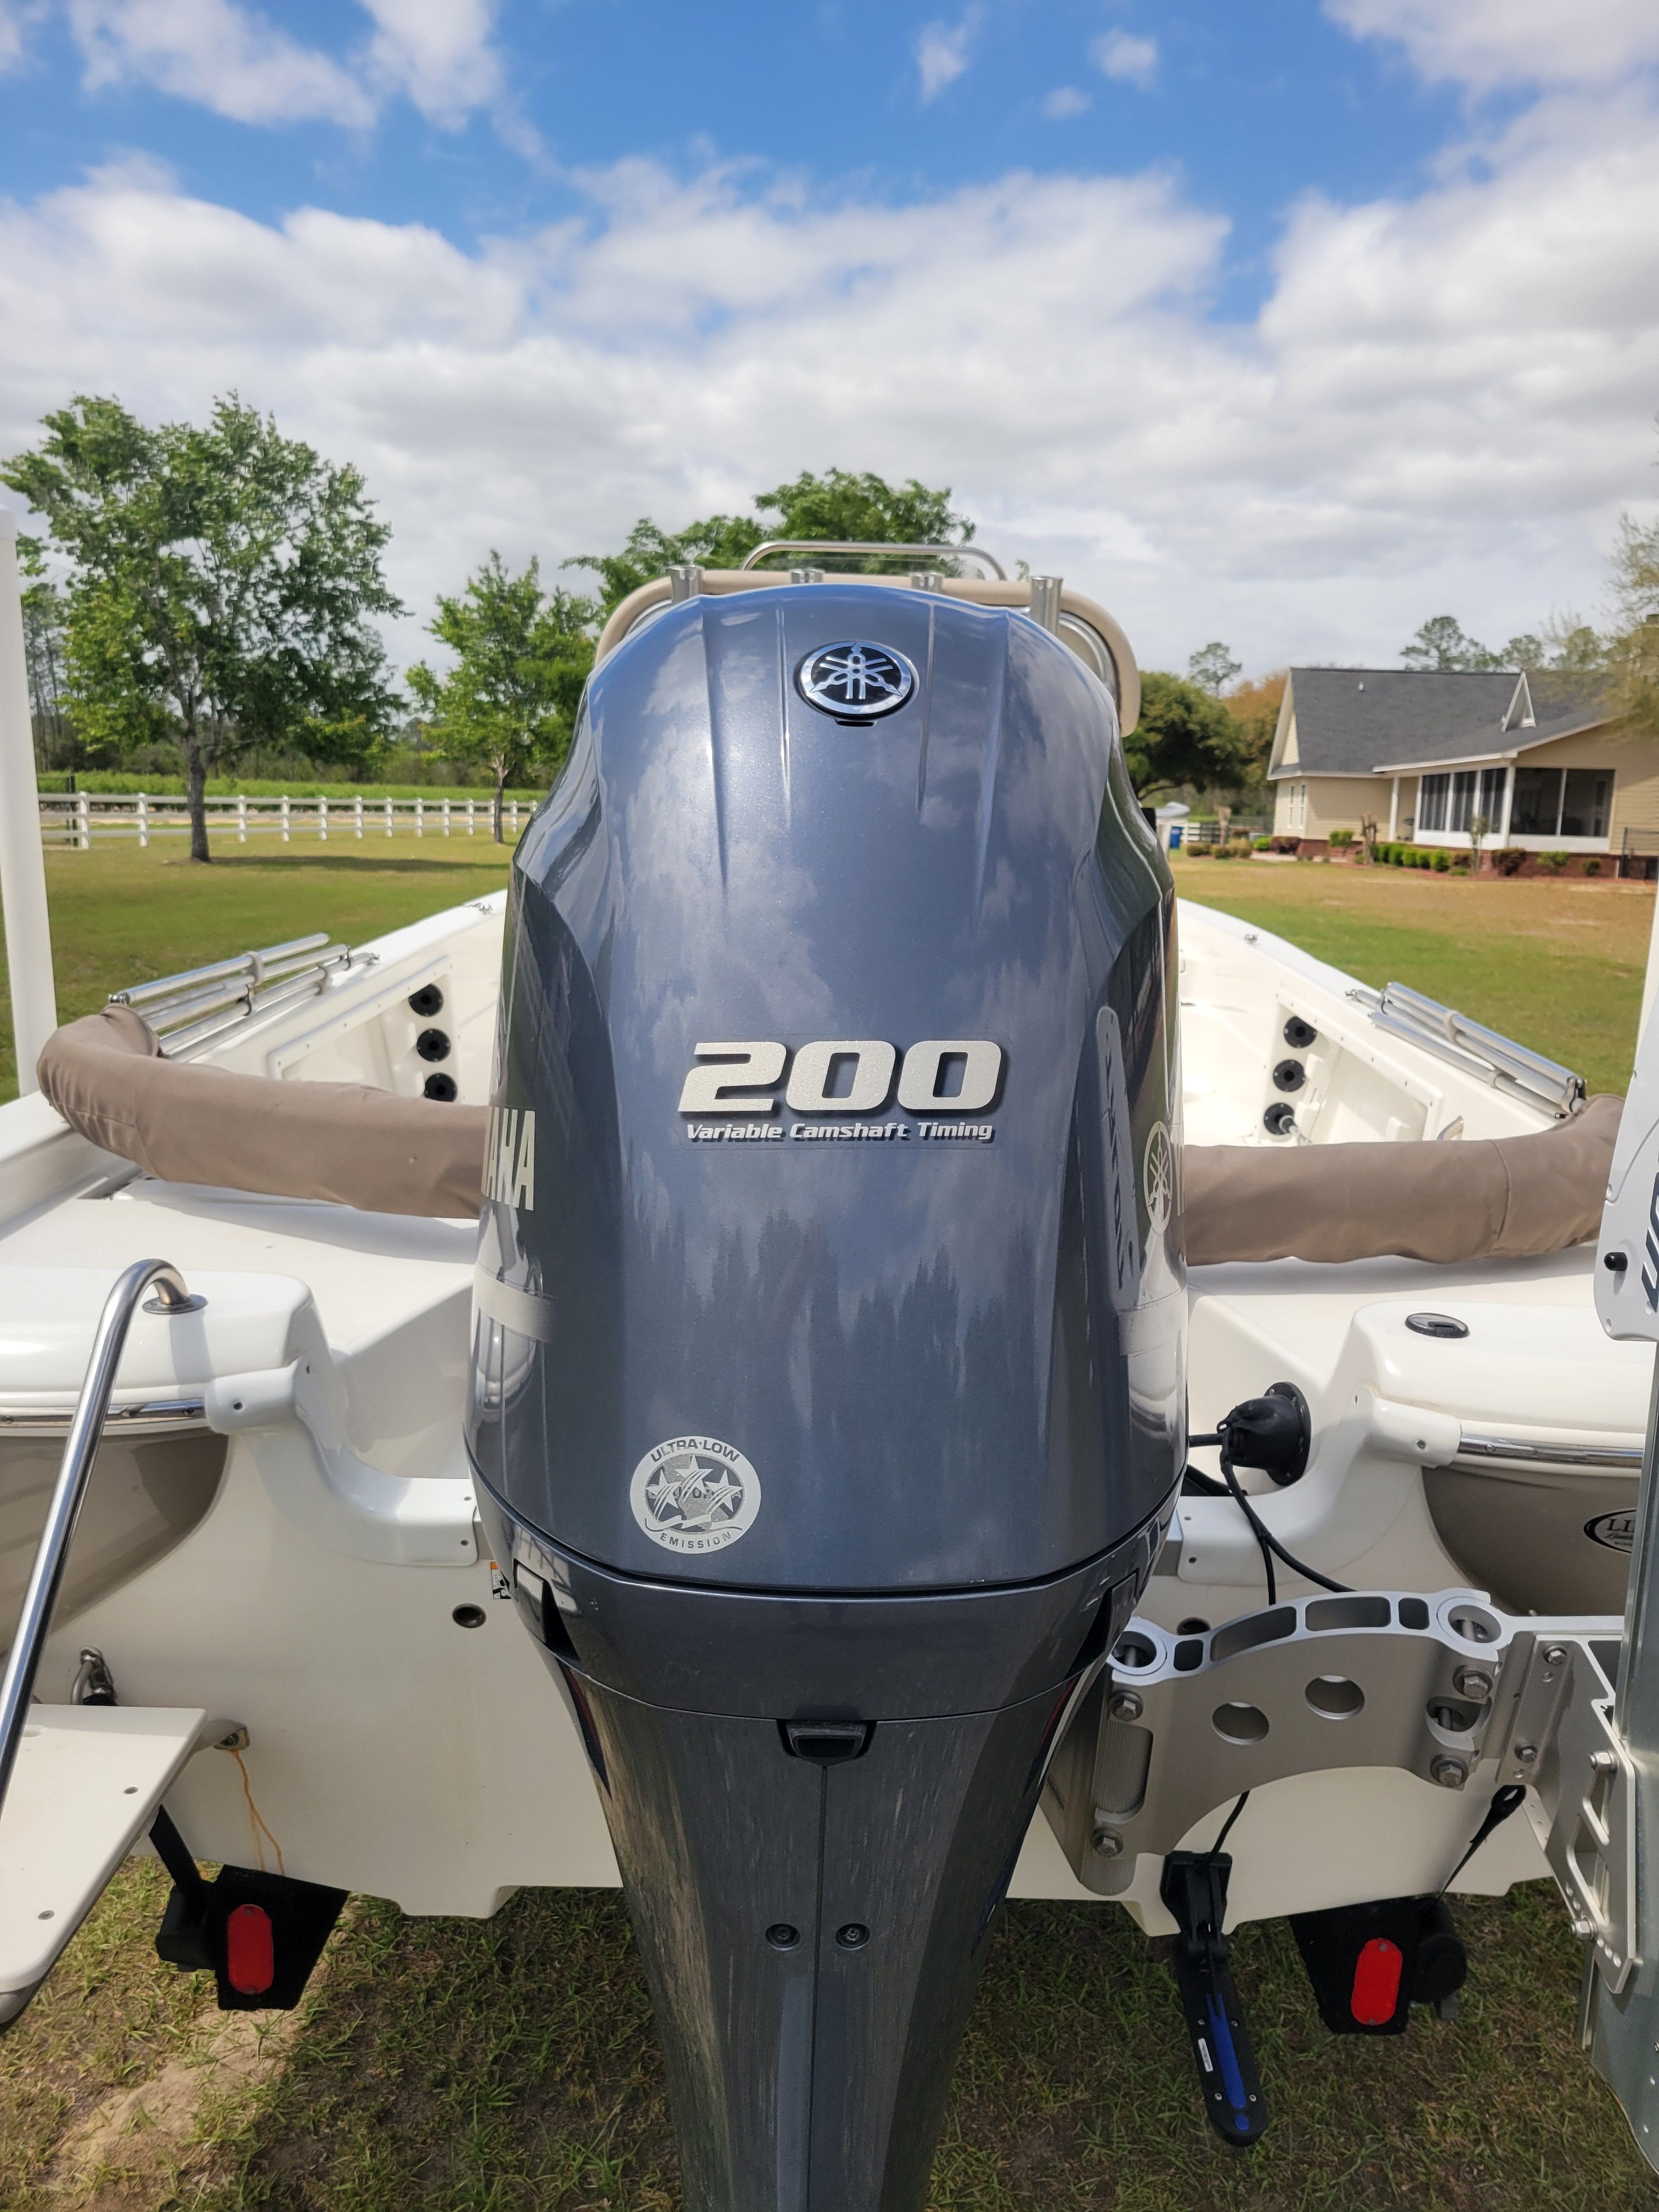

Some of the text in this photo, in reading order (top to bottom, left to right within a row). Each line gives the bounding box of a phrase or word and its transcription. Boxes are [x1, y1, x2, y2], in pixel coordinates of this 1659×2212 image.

[678, 1040, 1002, 1112] 200
[687, 1122, 992, 1139] Variable Camshaft Timing
[660, 1531, 732, 1549] EMISSION
